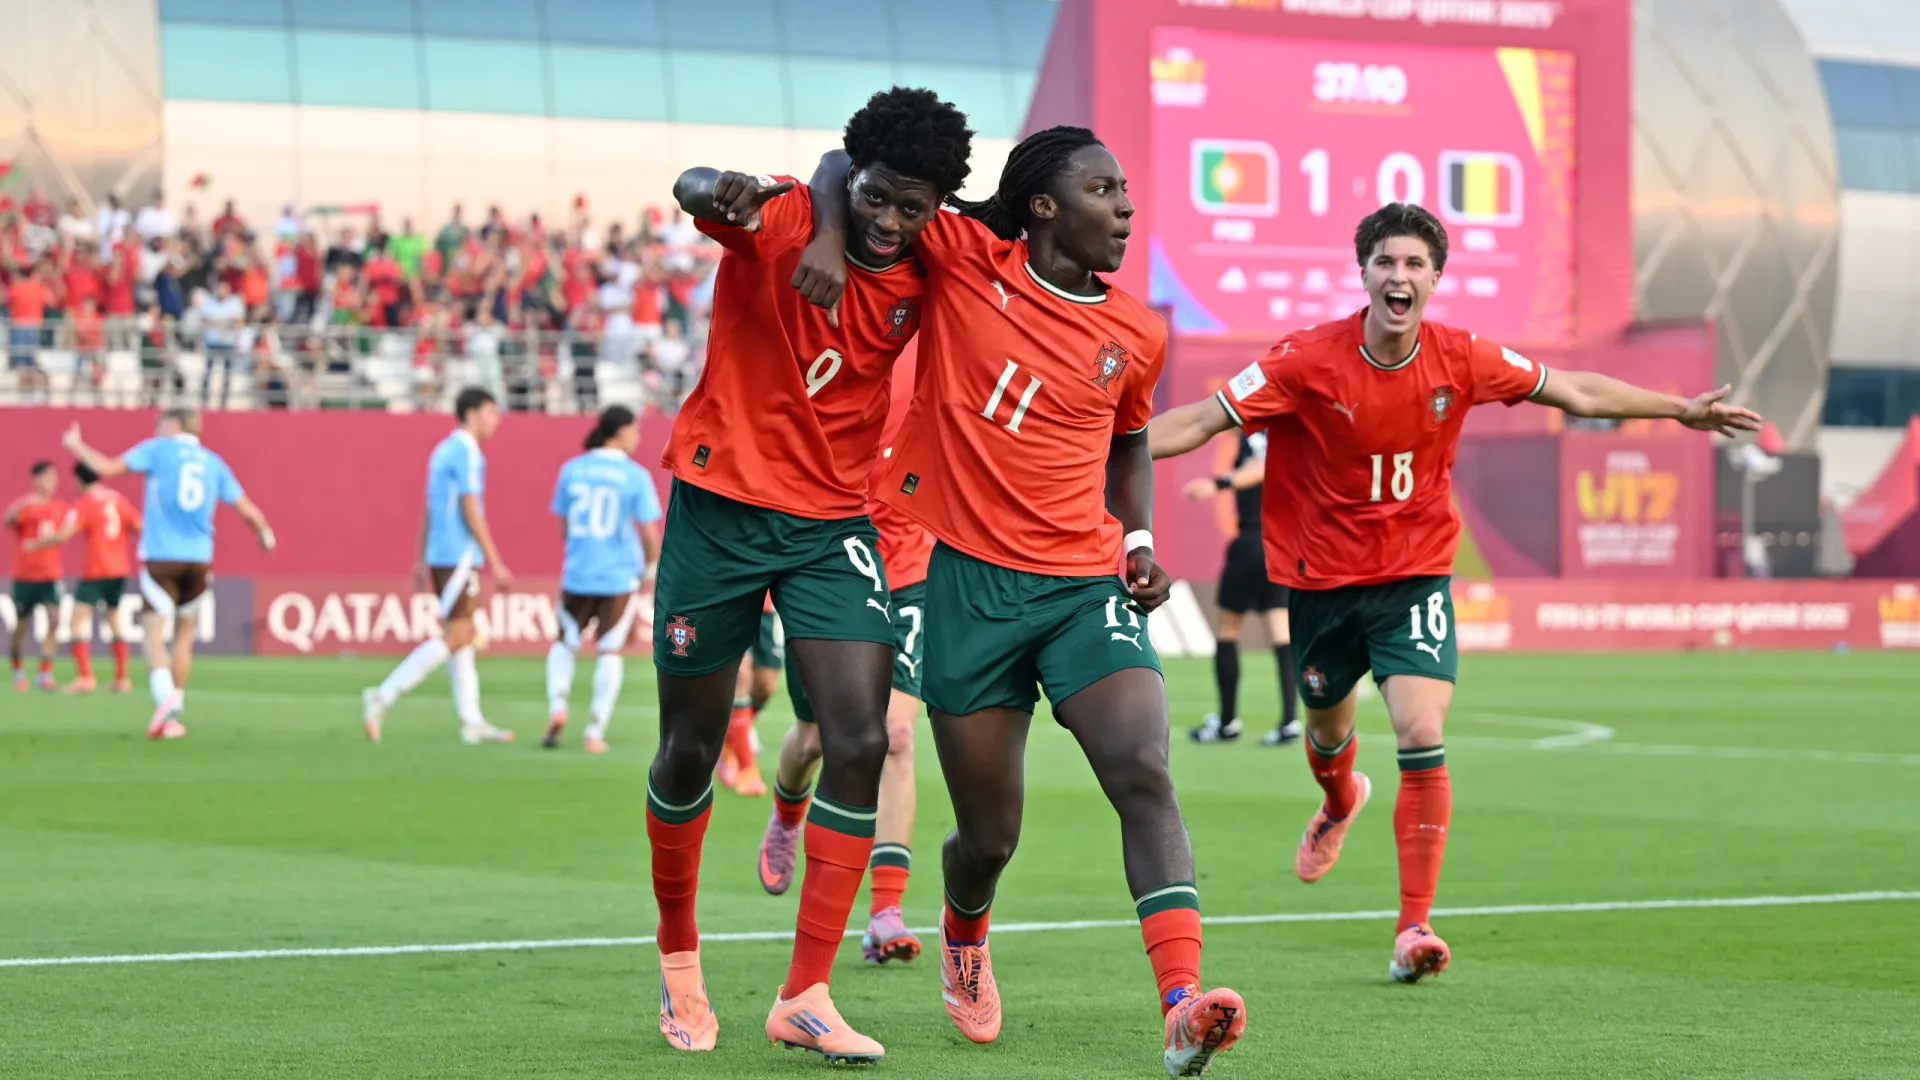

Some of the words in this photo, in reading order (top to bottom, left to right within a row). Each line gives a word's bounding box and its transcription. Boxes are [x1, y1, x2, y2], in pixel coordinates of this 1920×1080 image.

[1300, 147, 1329, 216] 1
[1376, 152, 1425, 207] 0
[806, 348, 842, 399] 9
[979, 358, 1042, 434] 11
[177, 461, 206, 513] 6
[1369, 450, 1415, 502] 18
[567, 482, 620, 539] 20
[843, 536, 884, 592] 9
[268, 592, 443, 652] QATAR
[1409, 591, 1447, 640] 18
[660, 1013, 691, 1047] F50
